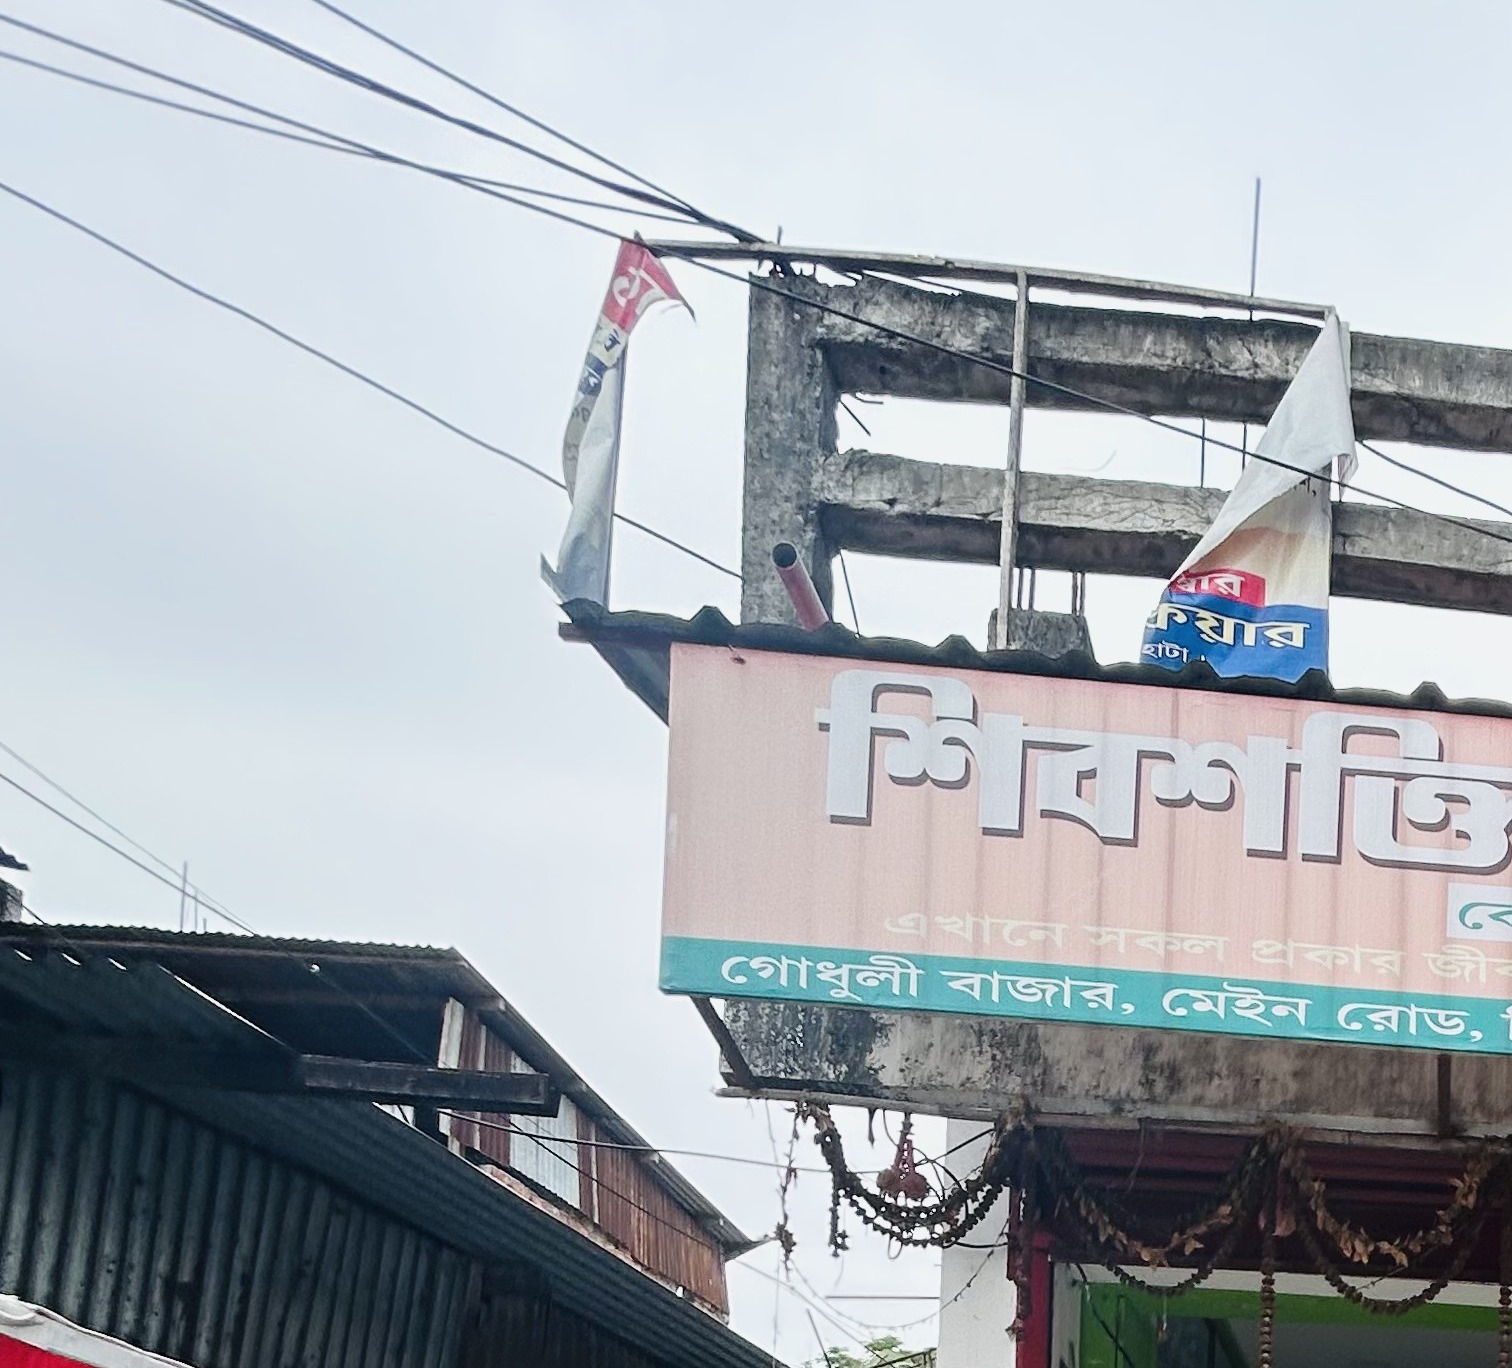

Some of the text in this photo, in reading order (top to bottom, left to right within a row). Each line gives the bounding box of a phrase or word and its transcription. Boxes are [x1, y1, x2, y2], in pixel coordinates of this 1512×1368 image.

[883, 911, 1069, 948] এখানে
[1084, 923, 1229, 963] সকল
[1250, 936, 1402, 976] প্রকার
[939, 969, 1136, 1017] বাজার,
[1161, 981, 1313, 1028] মেইন
[1336, 1002, 1483, 1043] রোড,
